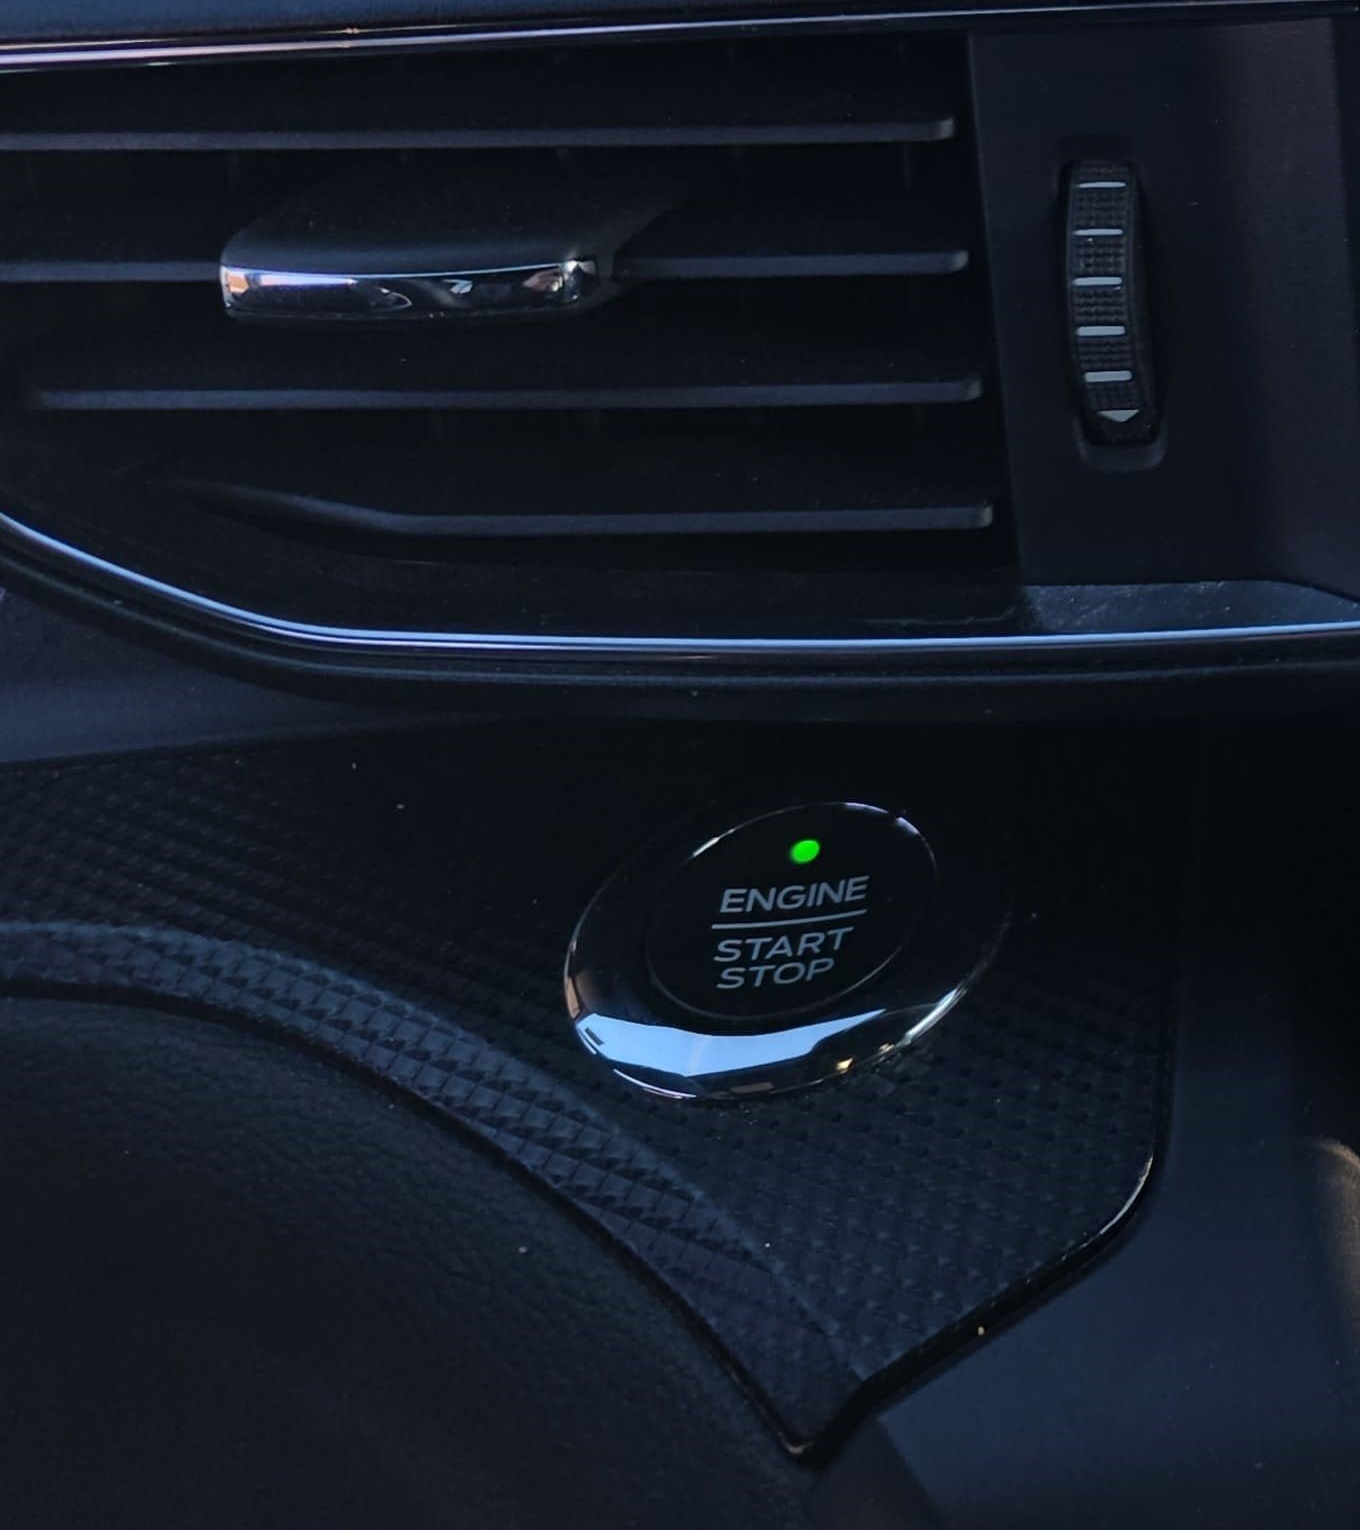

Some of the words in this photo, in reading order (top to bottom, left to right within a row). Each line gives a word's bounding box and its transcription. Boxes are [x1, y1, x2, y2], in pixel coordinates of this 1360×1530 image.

[719, 875, 870, 913] ENGINE
[713, 927, 854, 963] START
[716, 957, 834, 989] STOP
